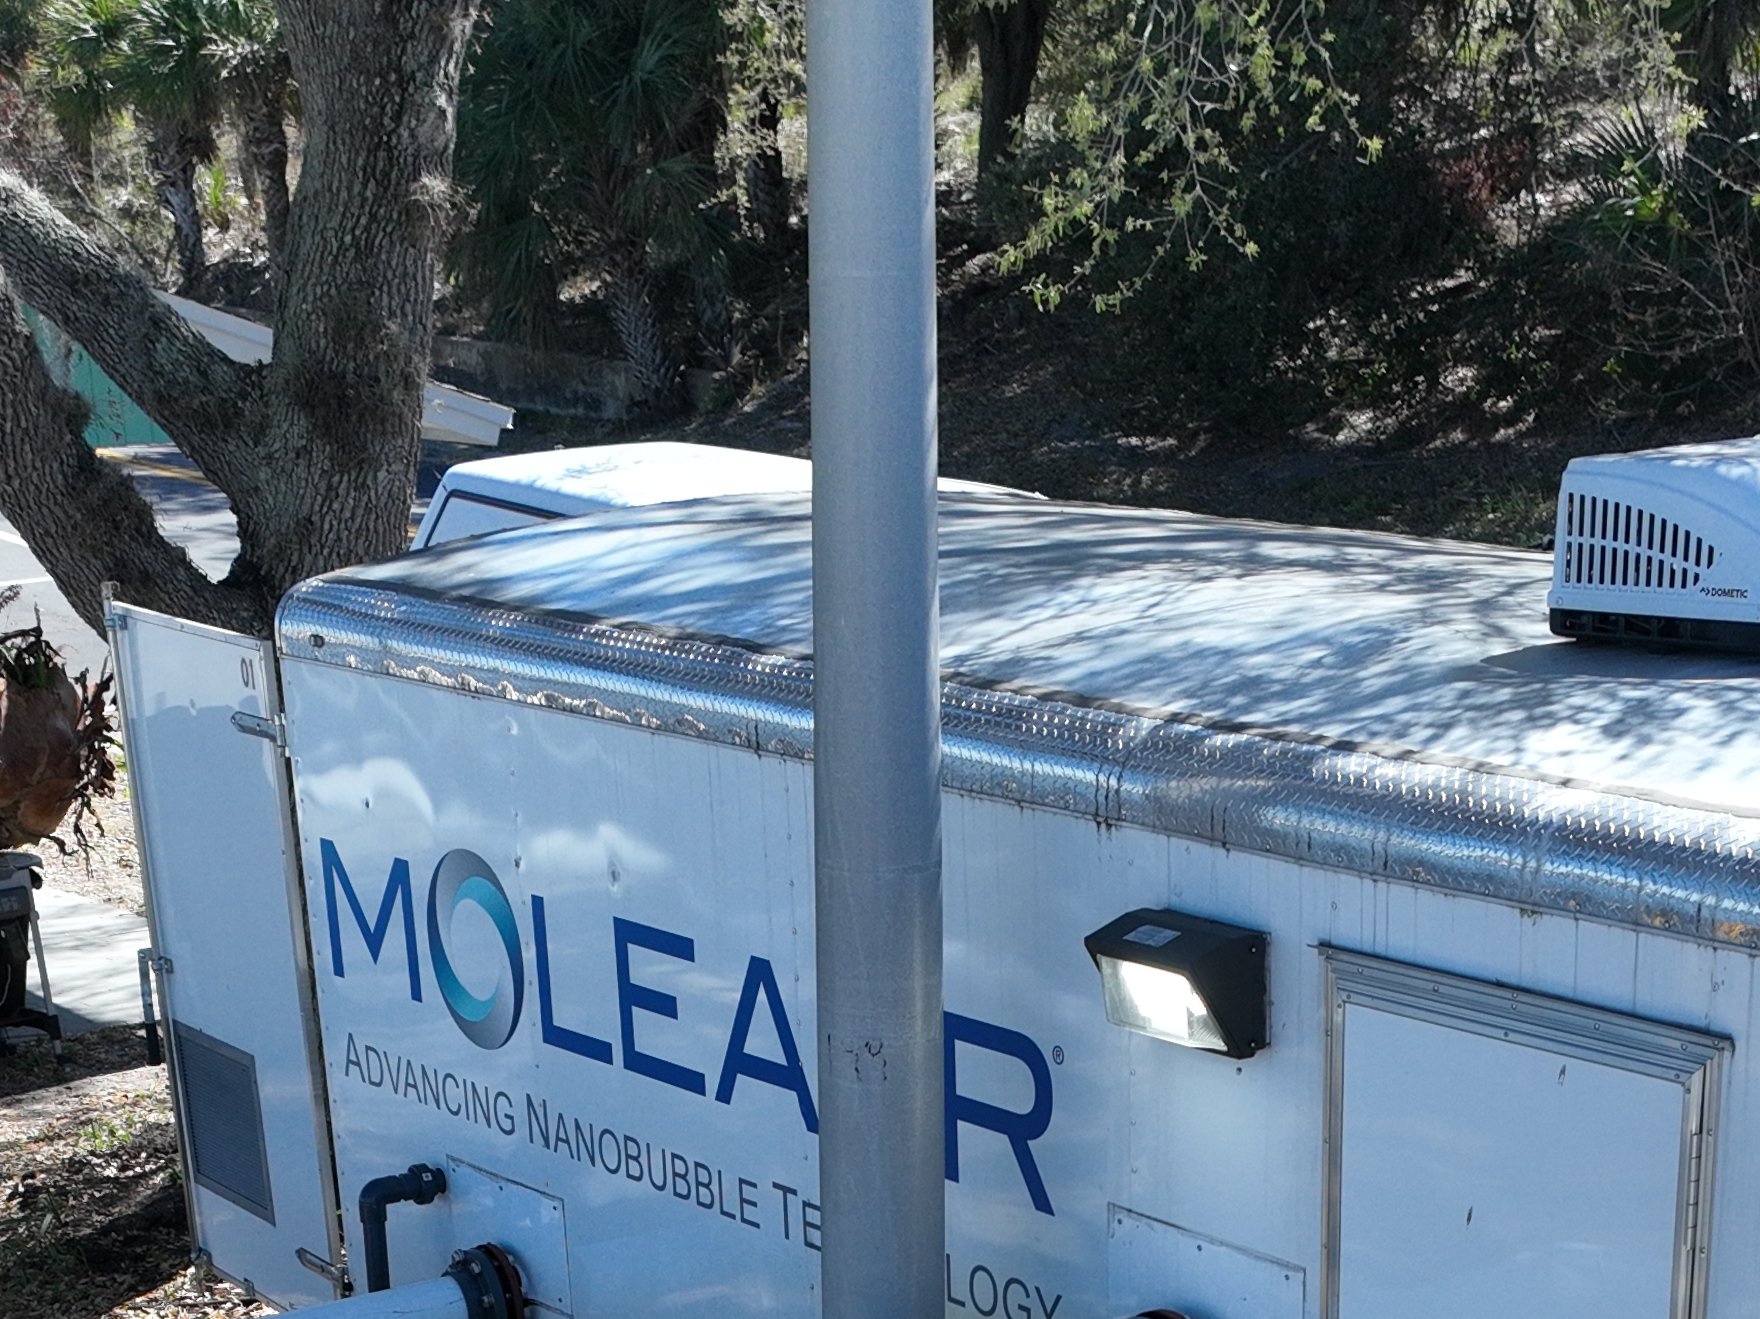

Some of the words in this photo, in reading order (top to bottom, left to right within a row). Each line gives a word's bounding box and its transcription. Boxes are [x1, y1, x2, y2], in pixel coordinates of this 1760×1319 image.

[1711, 587, 1748, 599] DOMETIC
[240, 657, 256, 690] 01
[344, 1032, 517, 1136] ADVANCING
[525, 1092, 761, 1230] NANOBUBBLE
